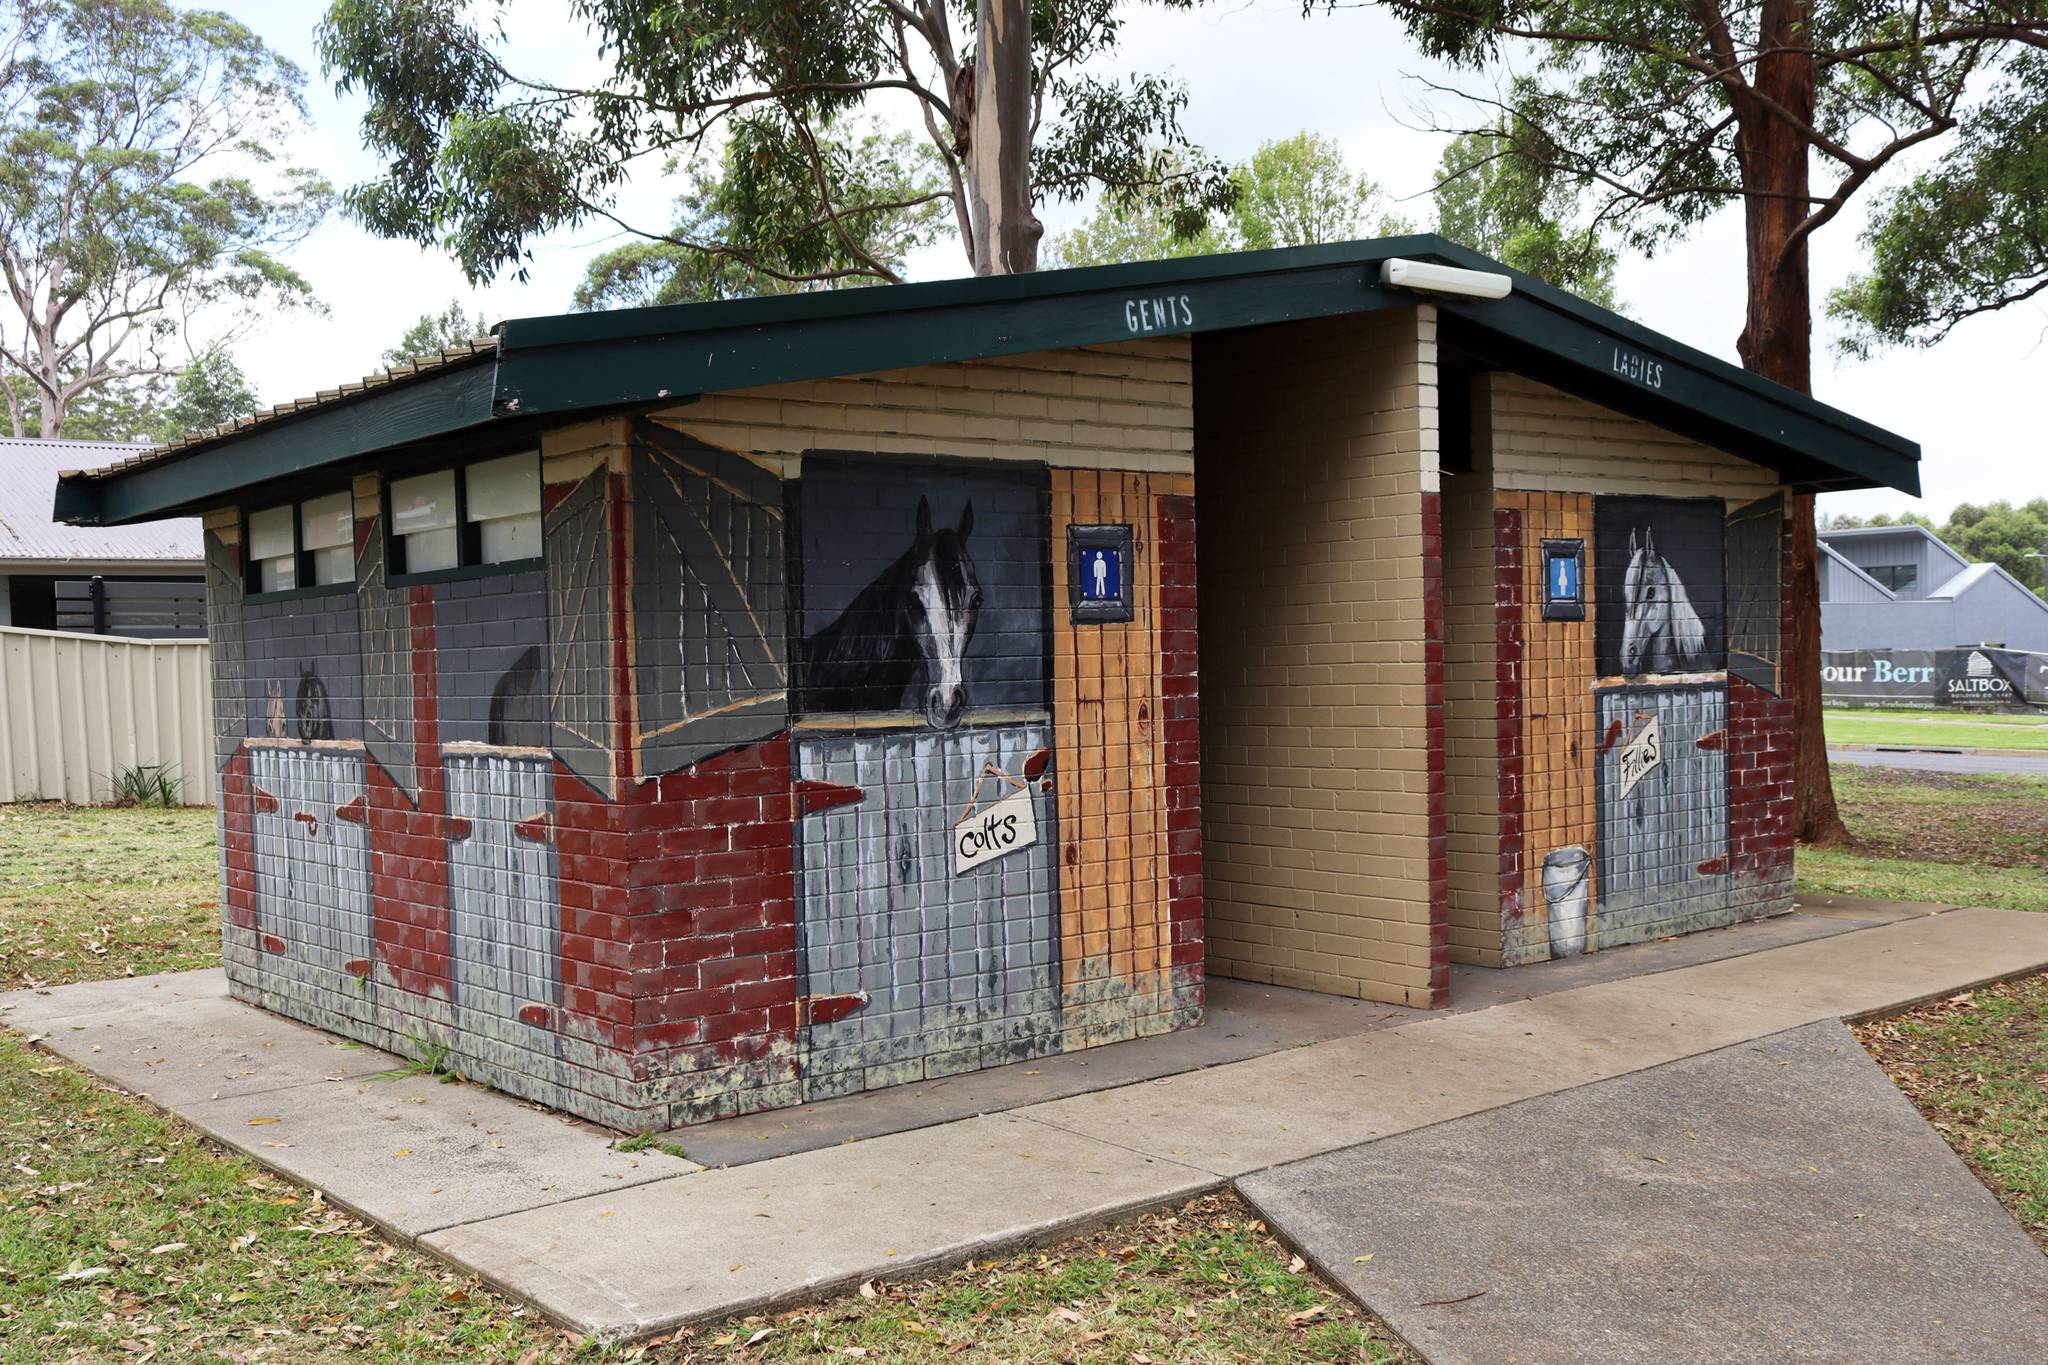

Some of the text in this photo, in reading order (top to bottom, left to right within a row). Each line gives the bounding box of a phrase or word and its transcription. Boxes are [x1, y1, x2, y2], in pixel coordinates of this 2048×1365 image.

[1125, 294, 1193, 332] GENTS
[1613, 347, 1662, 388] LADIES
[1819, 665, 1867, 682] our
[1948, 678, 2013, 692] SALTBOX
[1622, 733, 1657, 787] Fillies
[960, 814, 1017, 858] Colts
